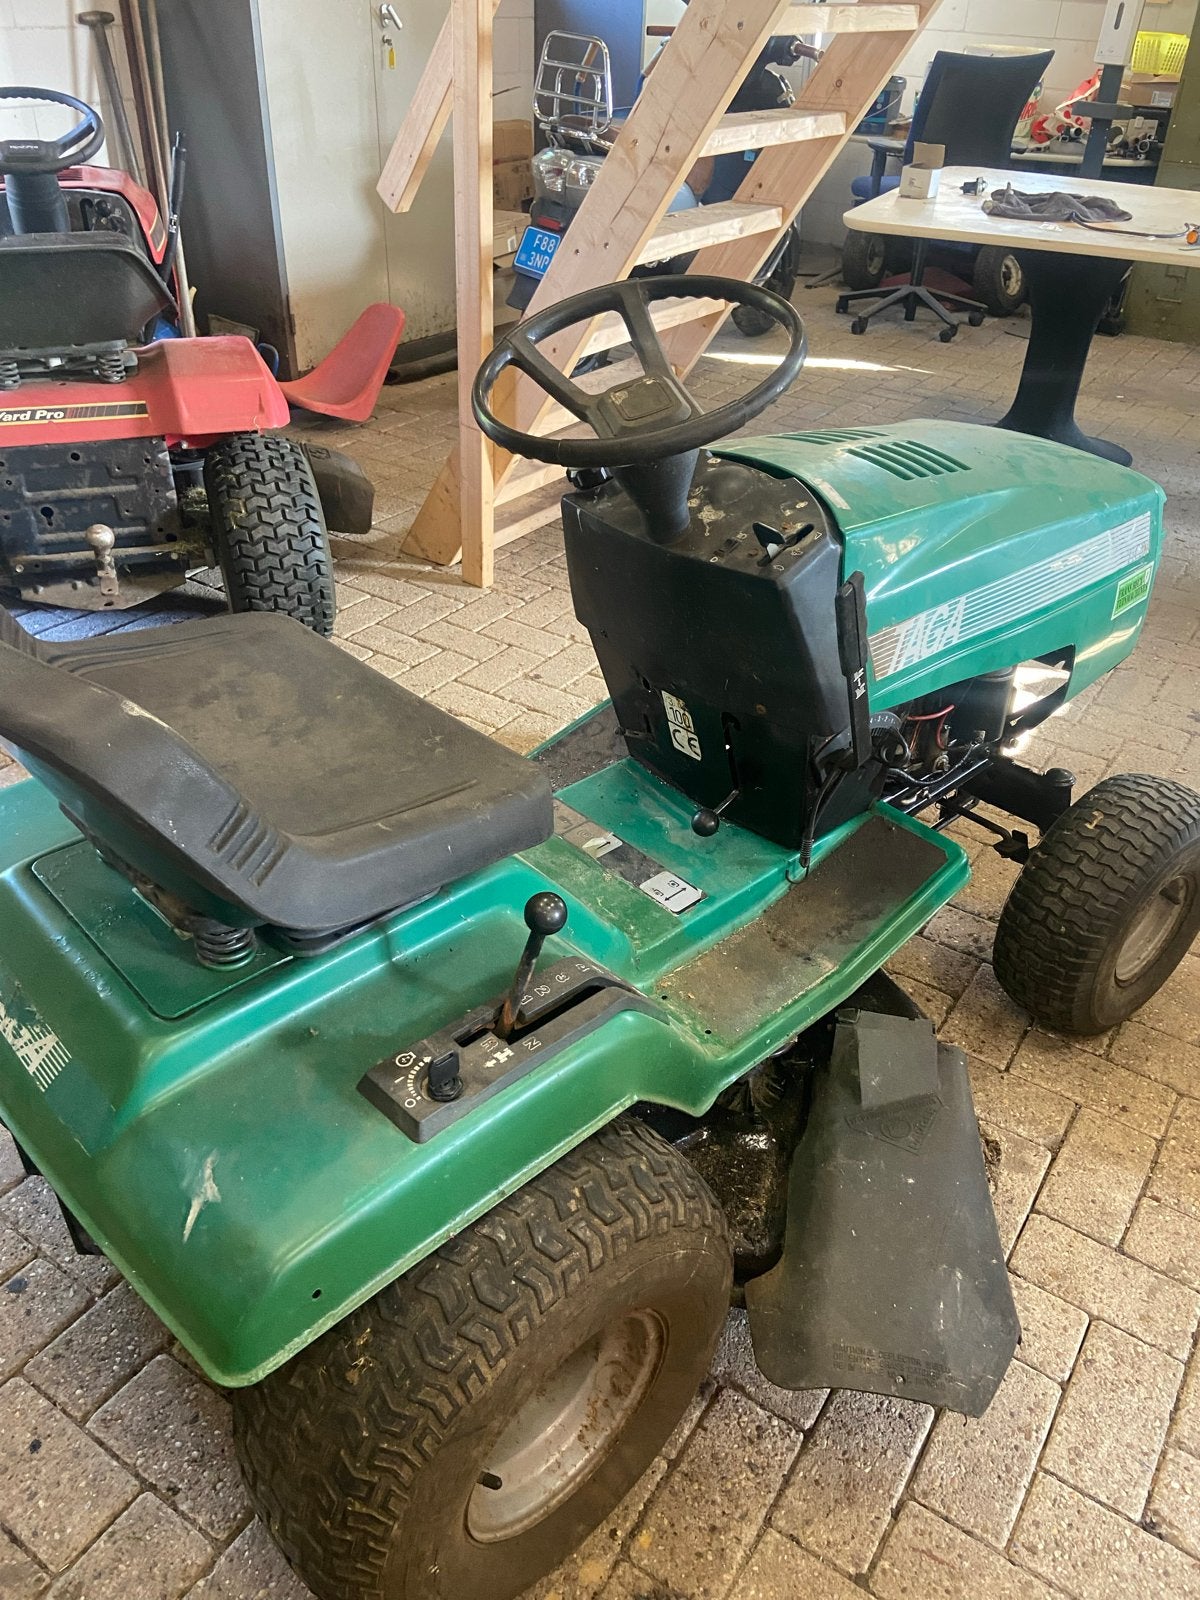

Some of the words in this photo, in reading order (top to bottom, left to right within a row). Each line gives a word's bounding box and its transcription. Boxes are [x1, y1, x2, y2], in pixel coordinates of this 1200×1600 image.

[533, 234, 556, 253] F88
[527, 252, 550, 269] 3NP
[35, 409, 65, 420] Pro
[669, 707, 691, 728] 100
[672, 728, 701, 757] CE
[534, 984, 551, 997] 2
[522, 1036, 543, 1051] N
